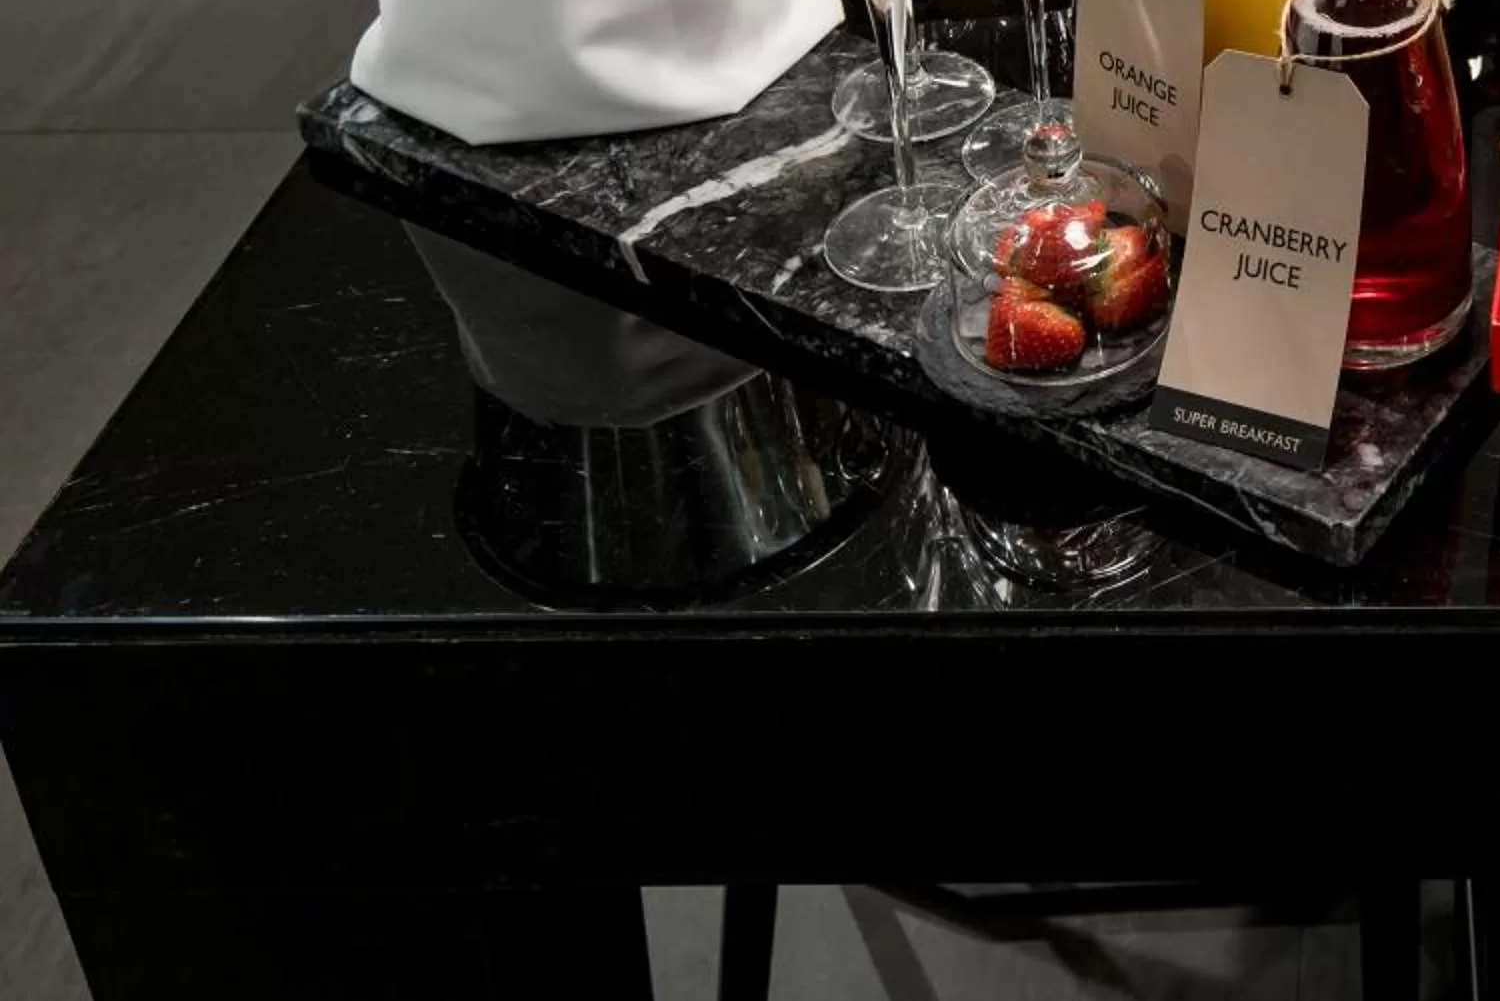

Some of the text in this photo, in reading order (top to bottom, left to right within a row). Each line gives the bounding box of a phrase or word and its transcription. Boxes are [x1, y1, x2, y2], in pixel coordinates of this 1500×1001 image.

[1099, 50, 1178, 106] ORANGE
[1111, 86, 1161, 127] JUICE
[1200, 209, 1348, 263] CRANBERRY
[1233, 251, 1302, 290] JUICE
[1173, 406, 1302, 453] SUPER BREAKFAST
